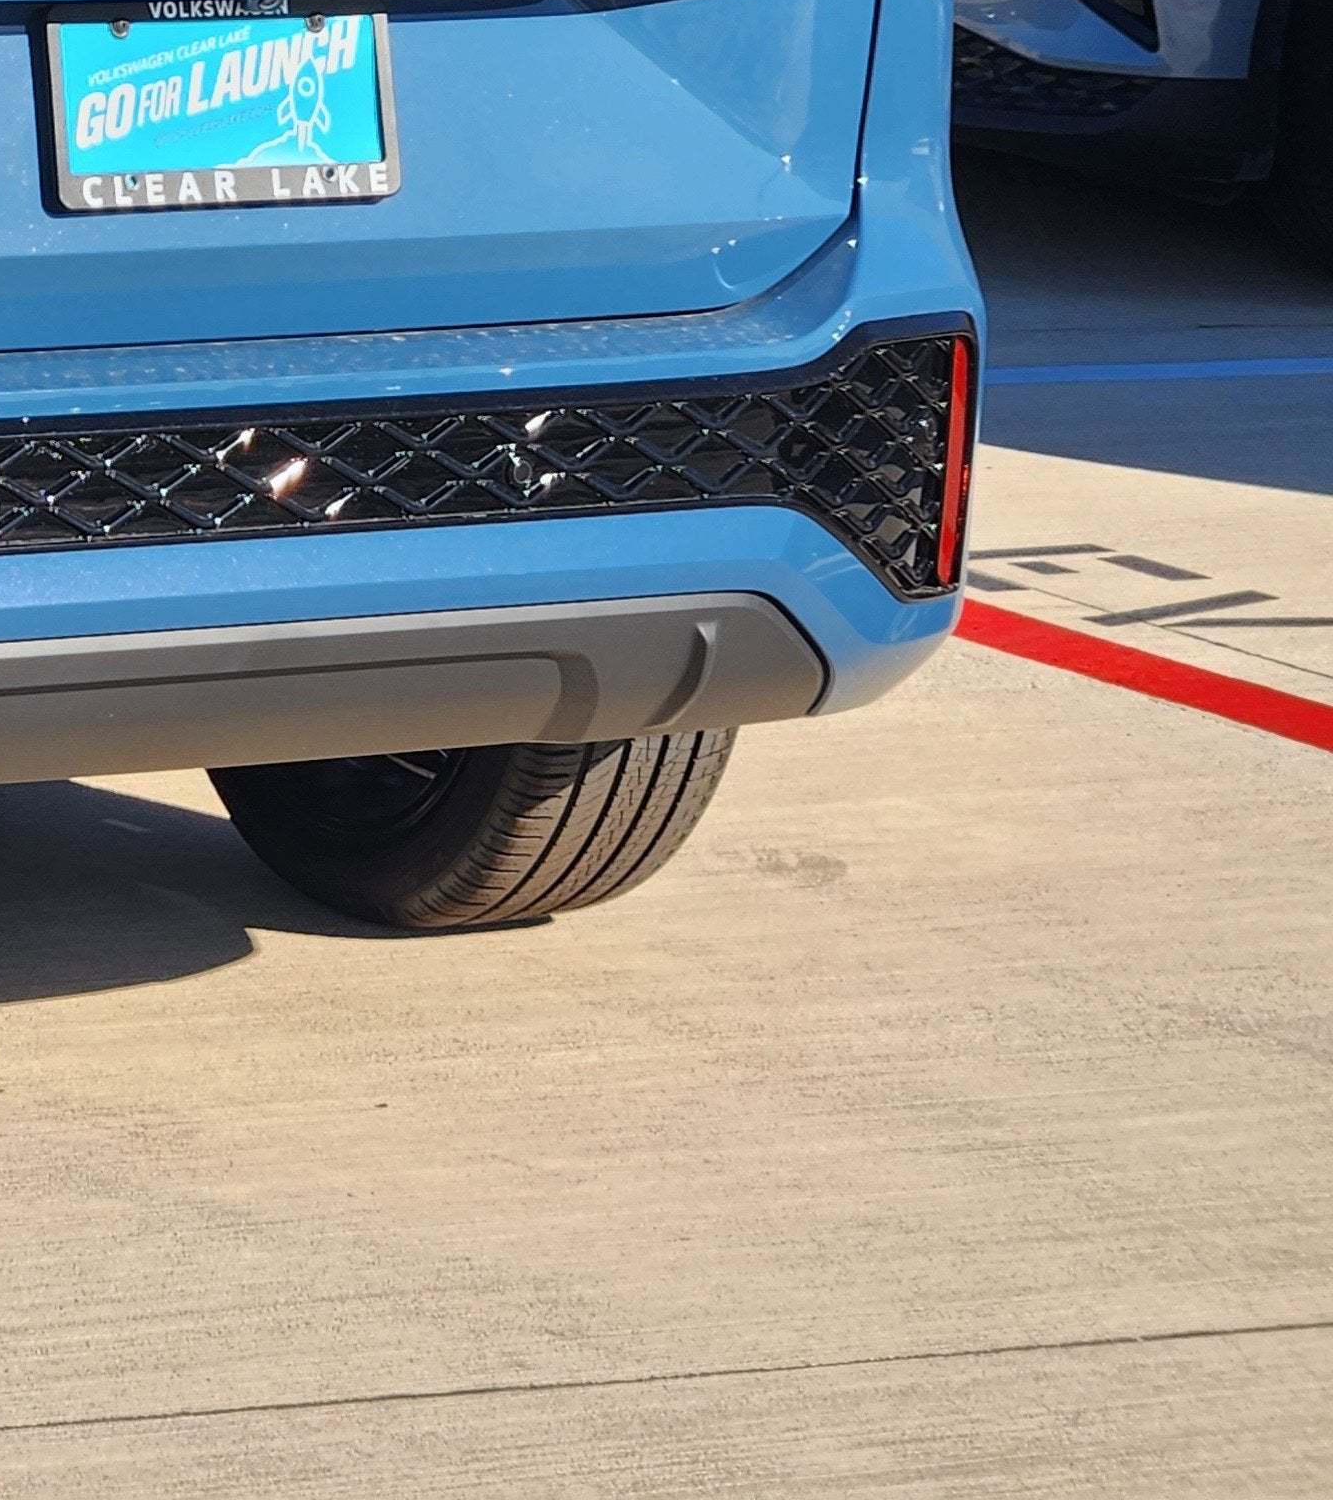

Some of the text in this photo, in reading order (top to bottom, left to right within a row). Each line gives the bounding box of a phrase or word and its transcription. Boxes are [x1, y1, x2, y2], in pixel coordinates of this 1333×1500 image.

[75, 83, 136, 150] GO
[137, 76, 182, 127] FOR
[187, 16, 360, 116] LAUNCH
[88, 25, 252, 87] VOLKSWAGEN CLEAR LAKE
[82, 163, 389, 206] CLEAR LAKE
